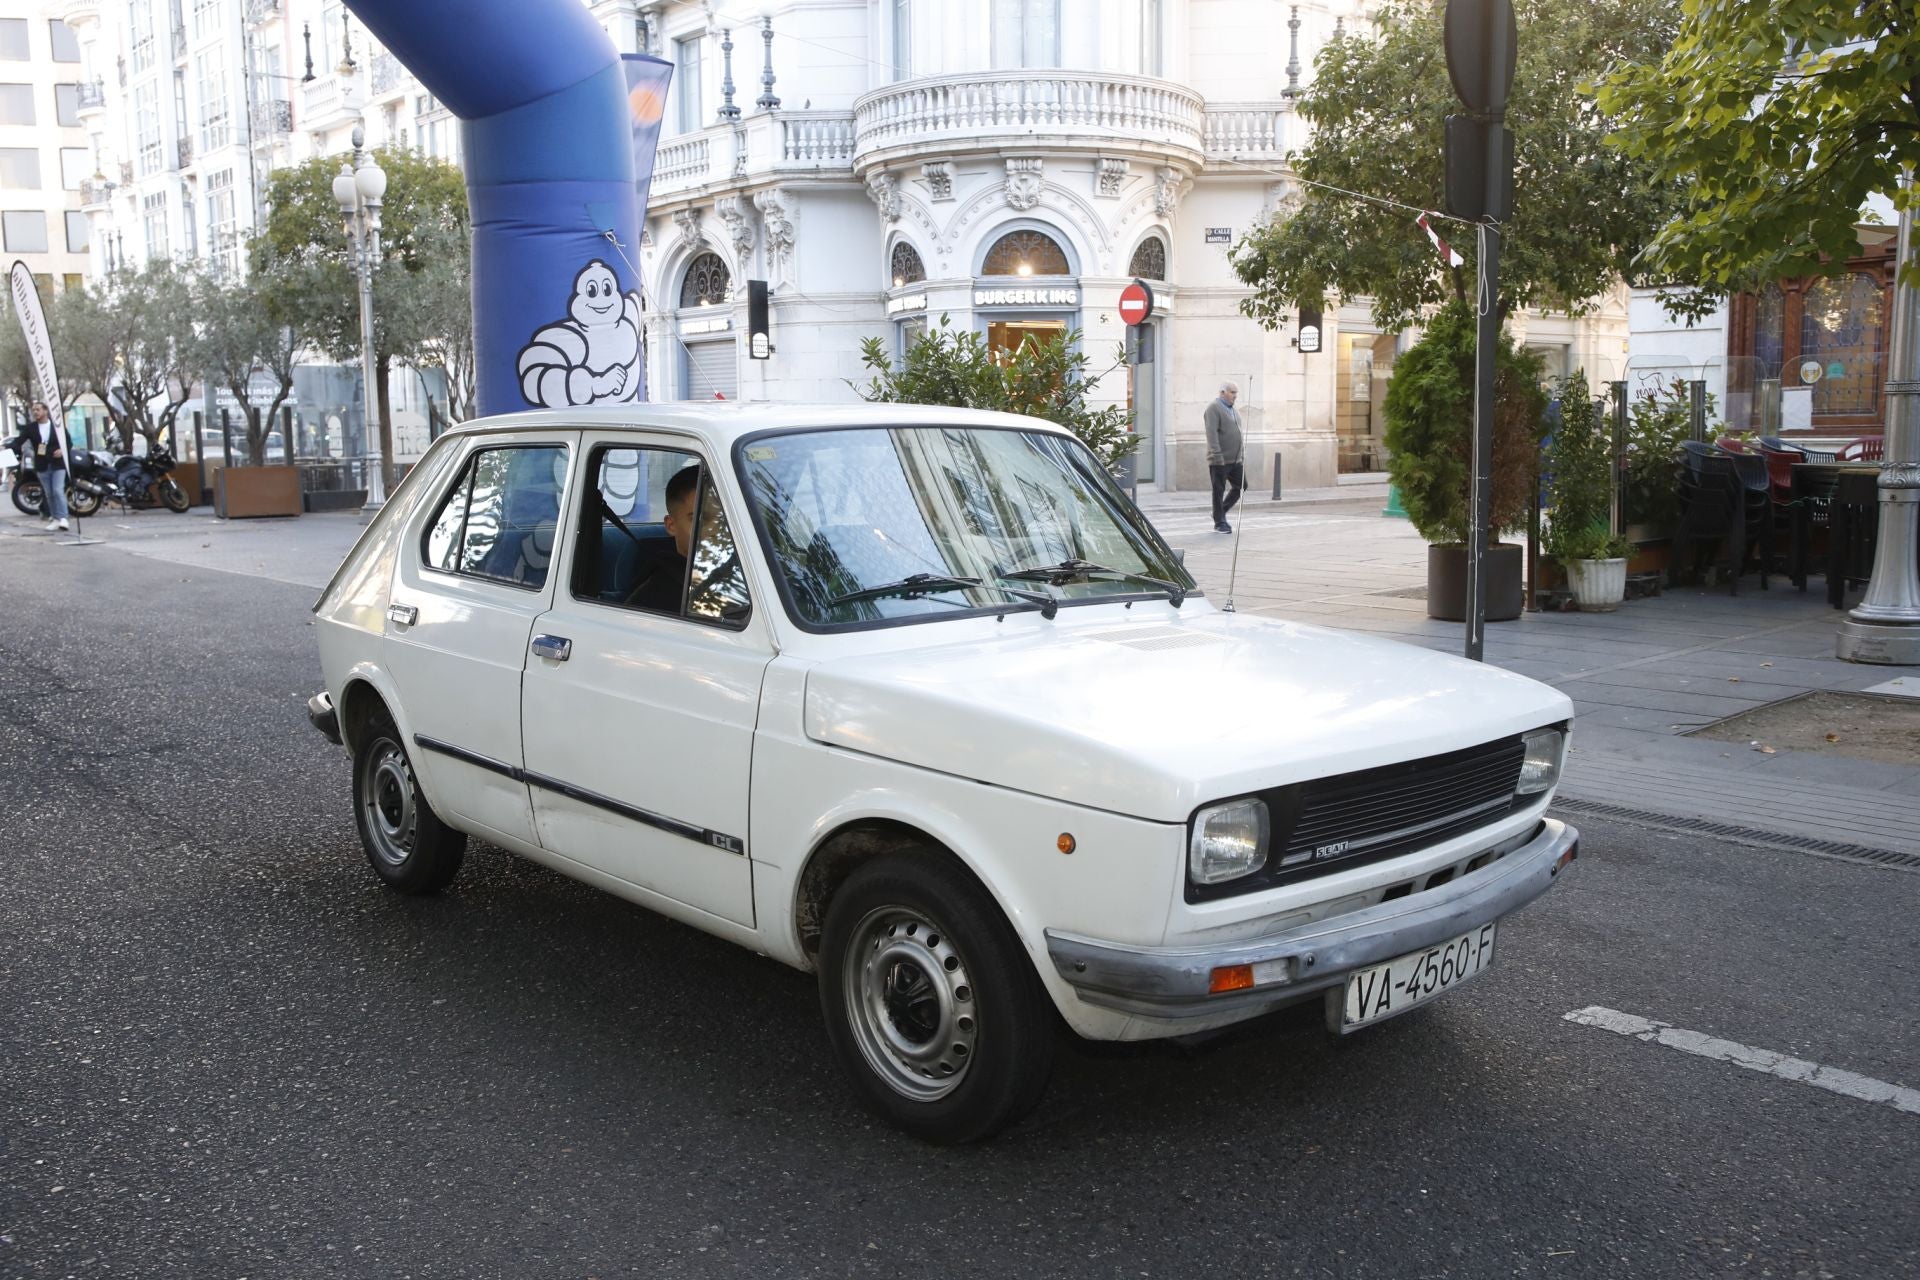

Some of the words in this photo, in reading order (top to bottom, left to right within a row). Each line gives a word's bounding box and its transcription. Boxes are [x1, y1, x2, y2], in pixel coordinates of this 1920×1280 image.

[975, 290, 1036, 304] BURGER
[1036, 289, 1077, 304] KING
[712, 834, 740, 851] CL
[1316, 841, 1349, 858] SEAT
